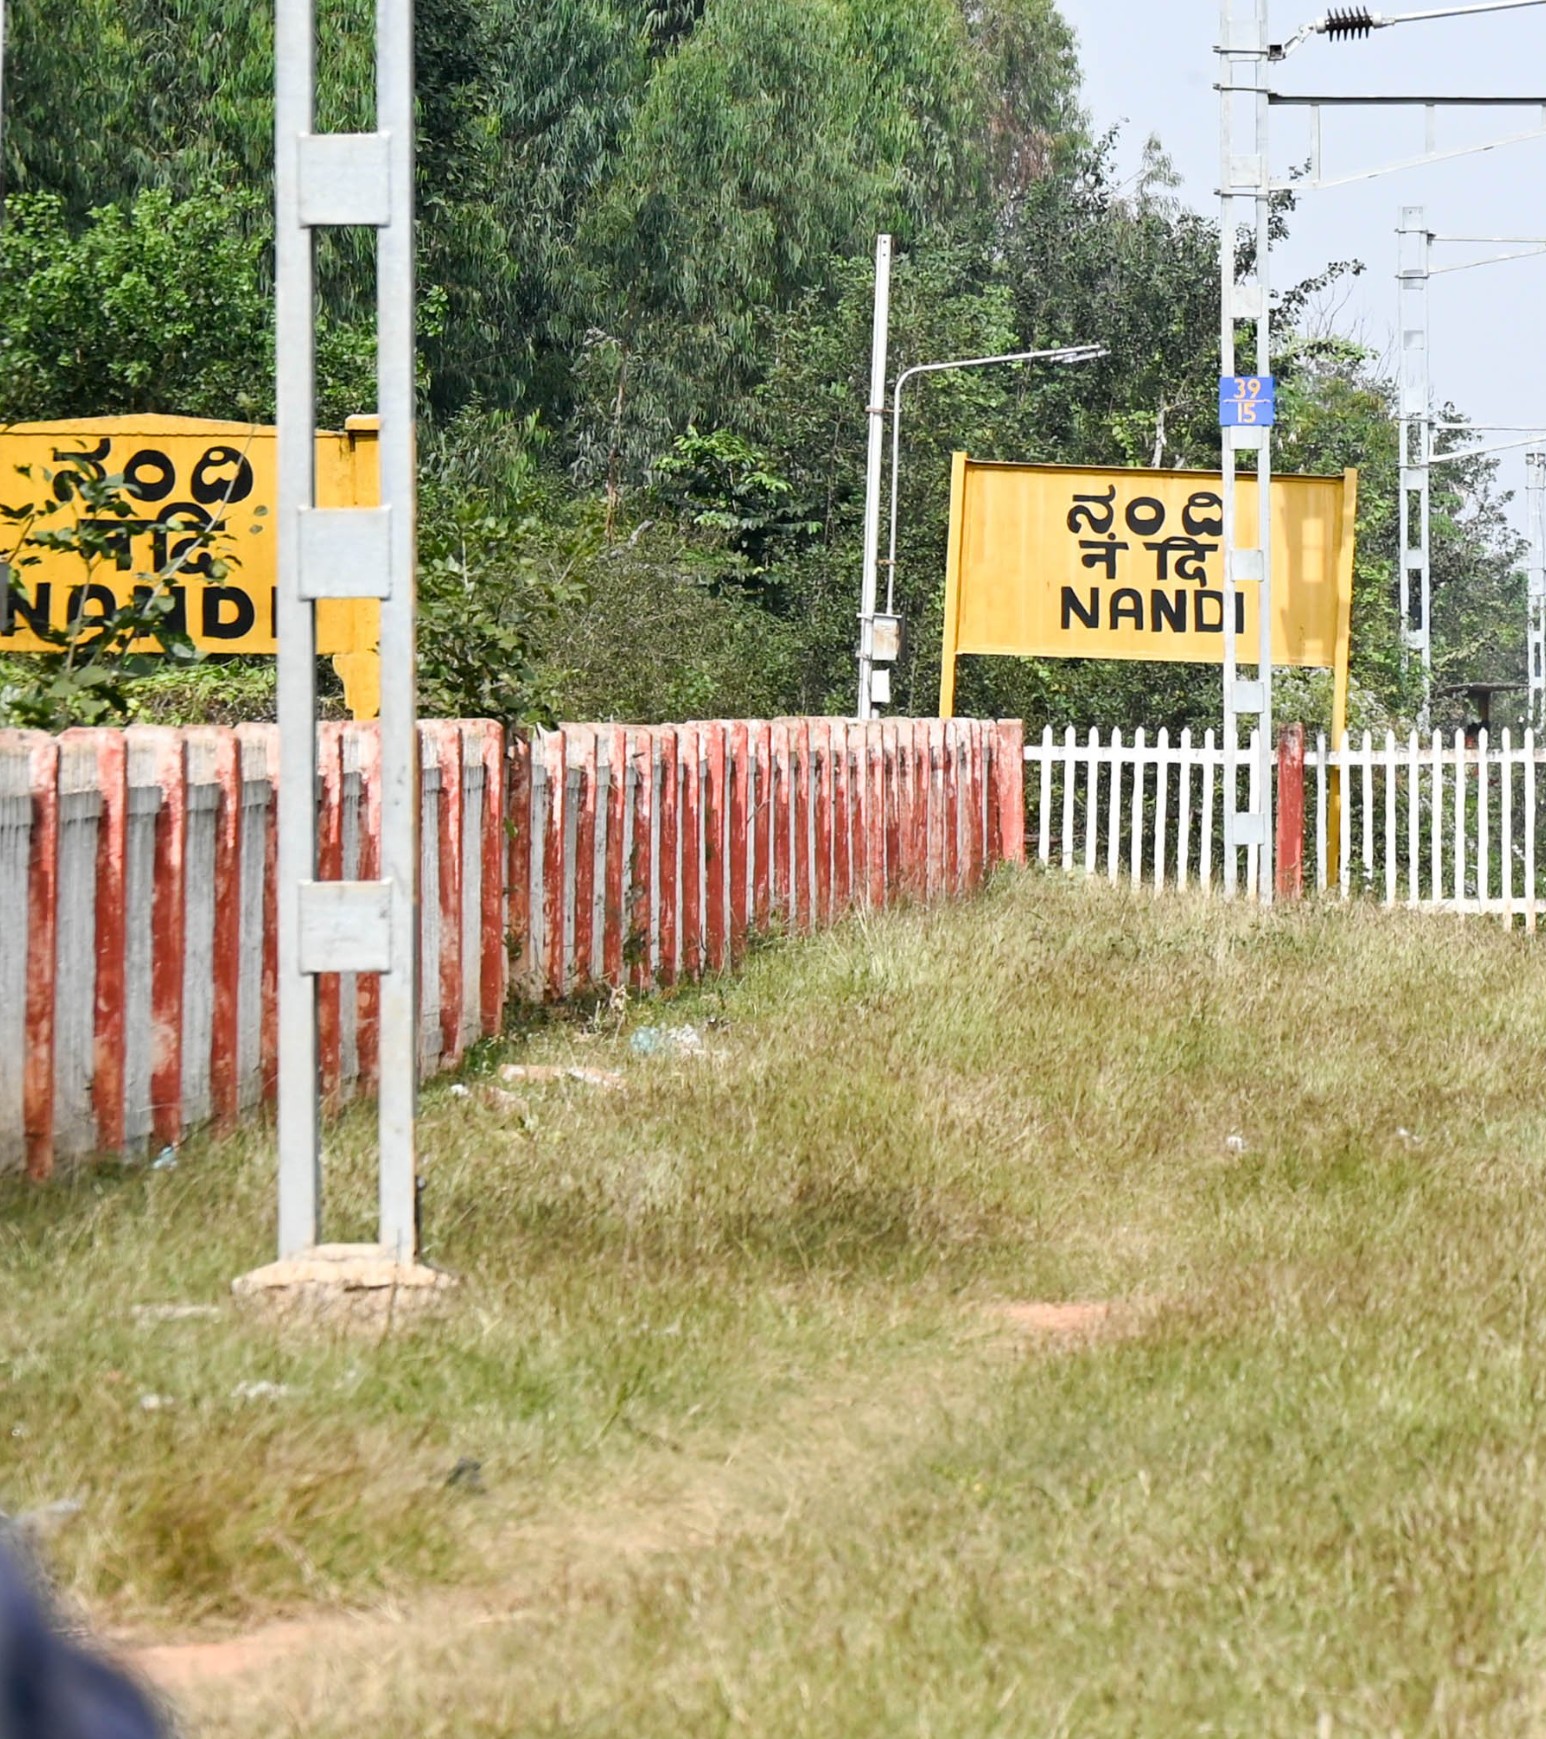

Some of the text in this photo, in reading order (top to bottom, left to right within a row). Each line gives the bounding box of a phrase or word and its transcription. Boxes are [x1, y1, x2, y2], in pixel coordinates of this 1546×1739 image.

[1233, 378, 1261, 399] 39
[1237, 402, 1256, 423] 15
[1061, 586, 1244, 634] NANDI
